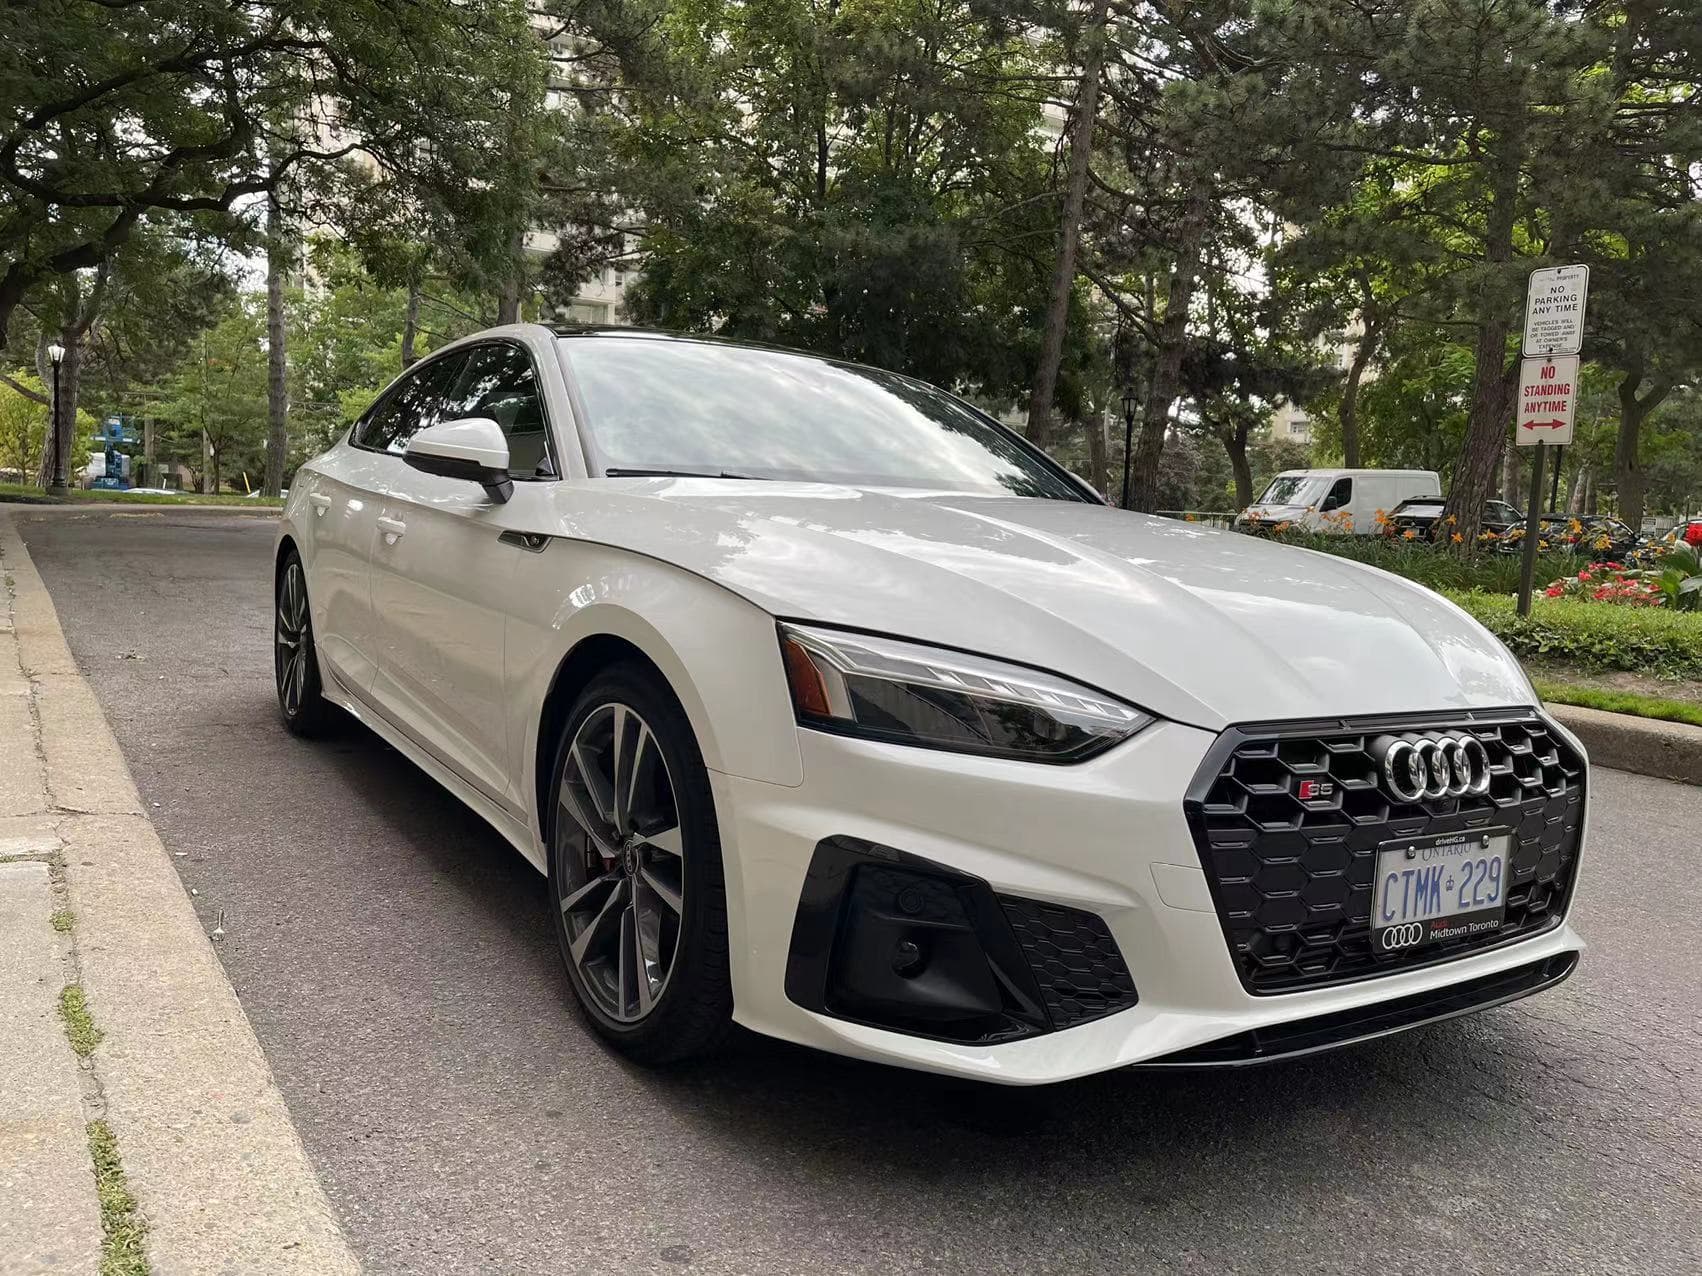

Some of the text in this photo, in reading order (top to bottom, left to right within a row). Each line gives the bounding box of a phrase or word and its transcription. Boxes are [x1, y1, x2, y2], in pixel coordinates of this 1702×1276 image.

[1550, 285, 1565, 294] NO
[1535, 294, 1577, 305] PARKING
[1532, 304, 1578, 315] ANY TIME
[1540, 365, 1556, 379] NO
[1524, 383, 1571, 397] STANDING
[1524, 400, 1567, 414] ANYTIME
[1382, 855, 1502, 922] CTMK 229
[1430, 919, 1499, 940] Midtown Toronto
